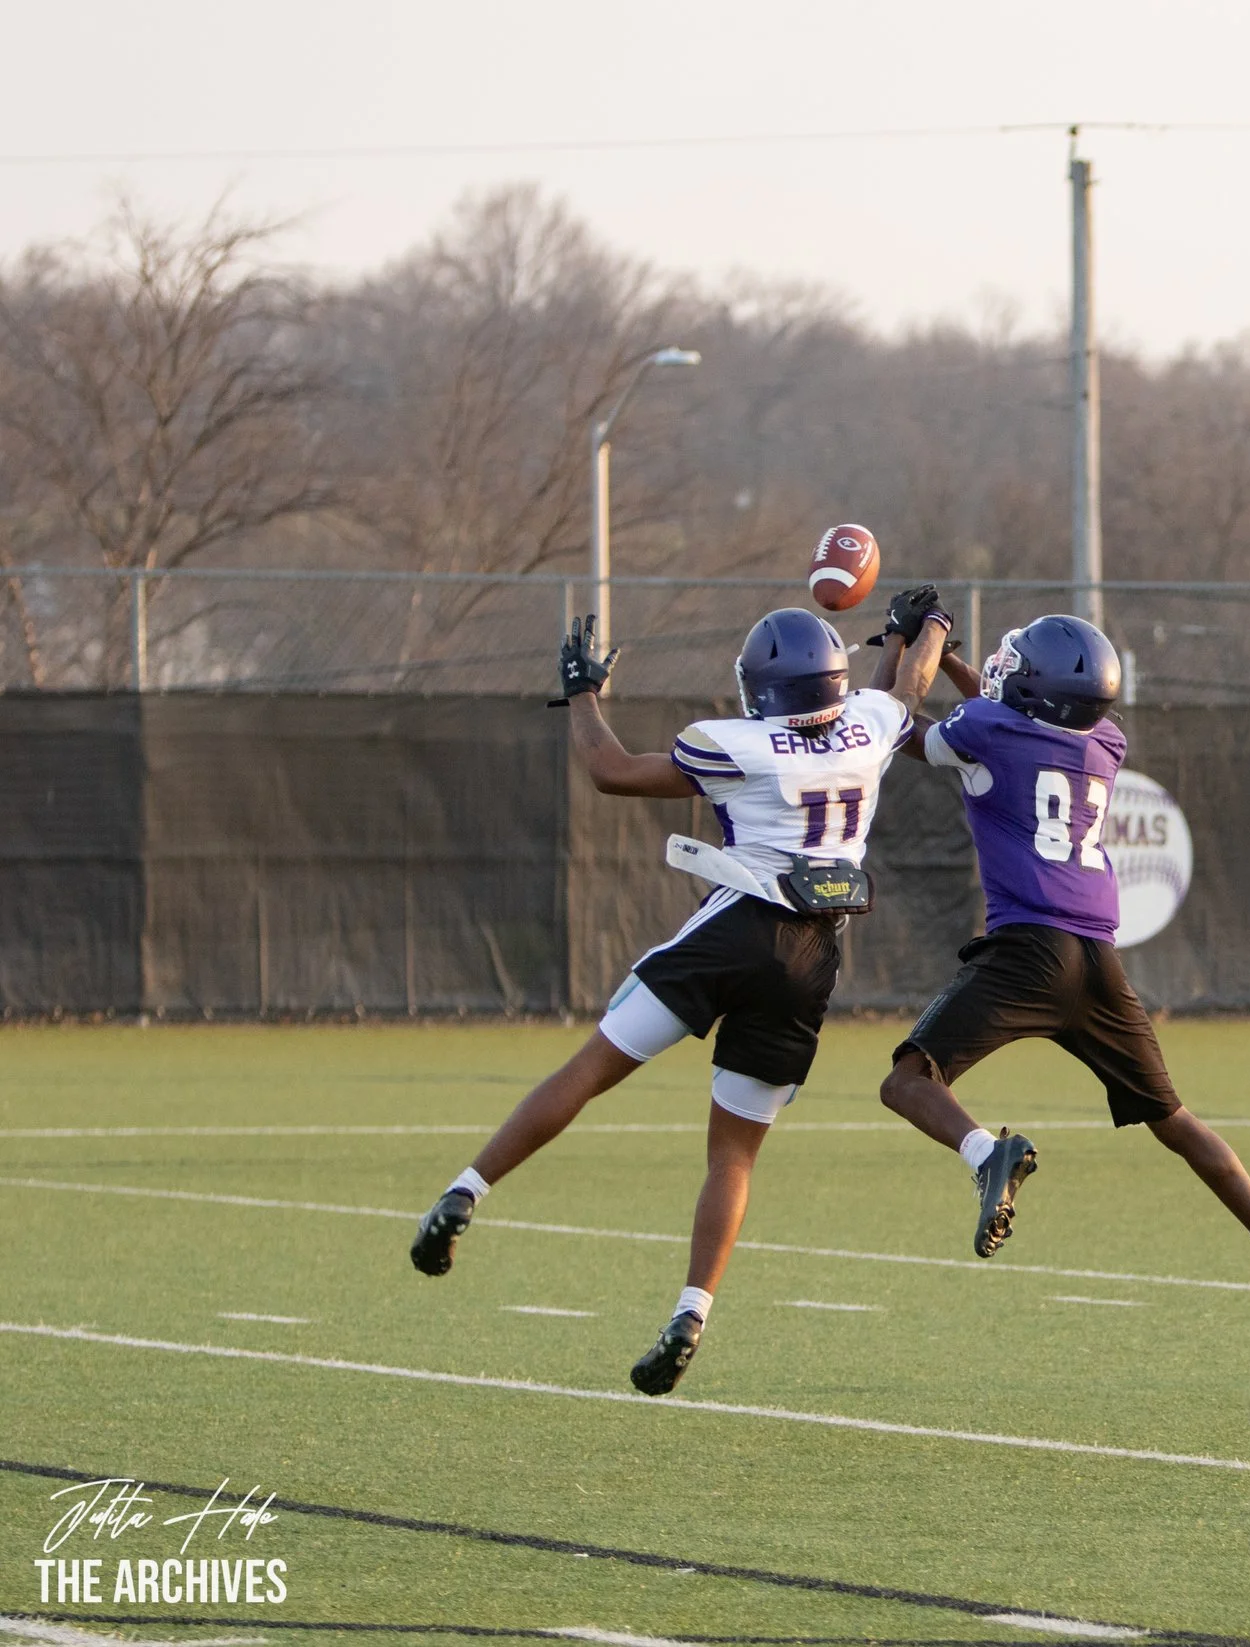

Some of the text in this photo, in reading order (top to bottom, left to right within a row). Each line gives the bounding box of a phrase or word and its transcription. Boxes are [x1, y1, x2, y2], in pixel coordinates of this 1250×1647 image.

[788, 709, 838, 727] Riddell
[769, 723, 872, 754] EAGLES
[798, 785, 865, 849] 11
[1104, 813, 1167, 846] MAS
